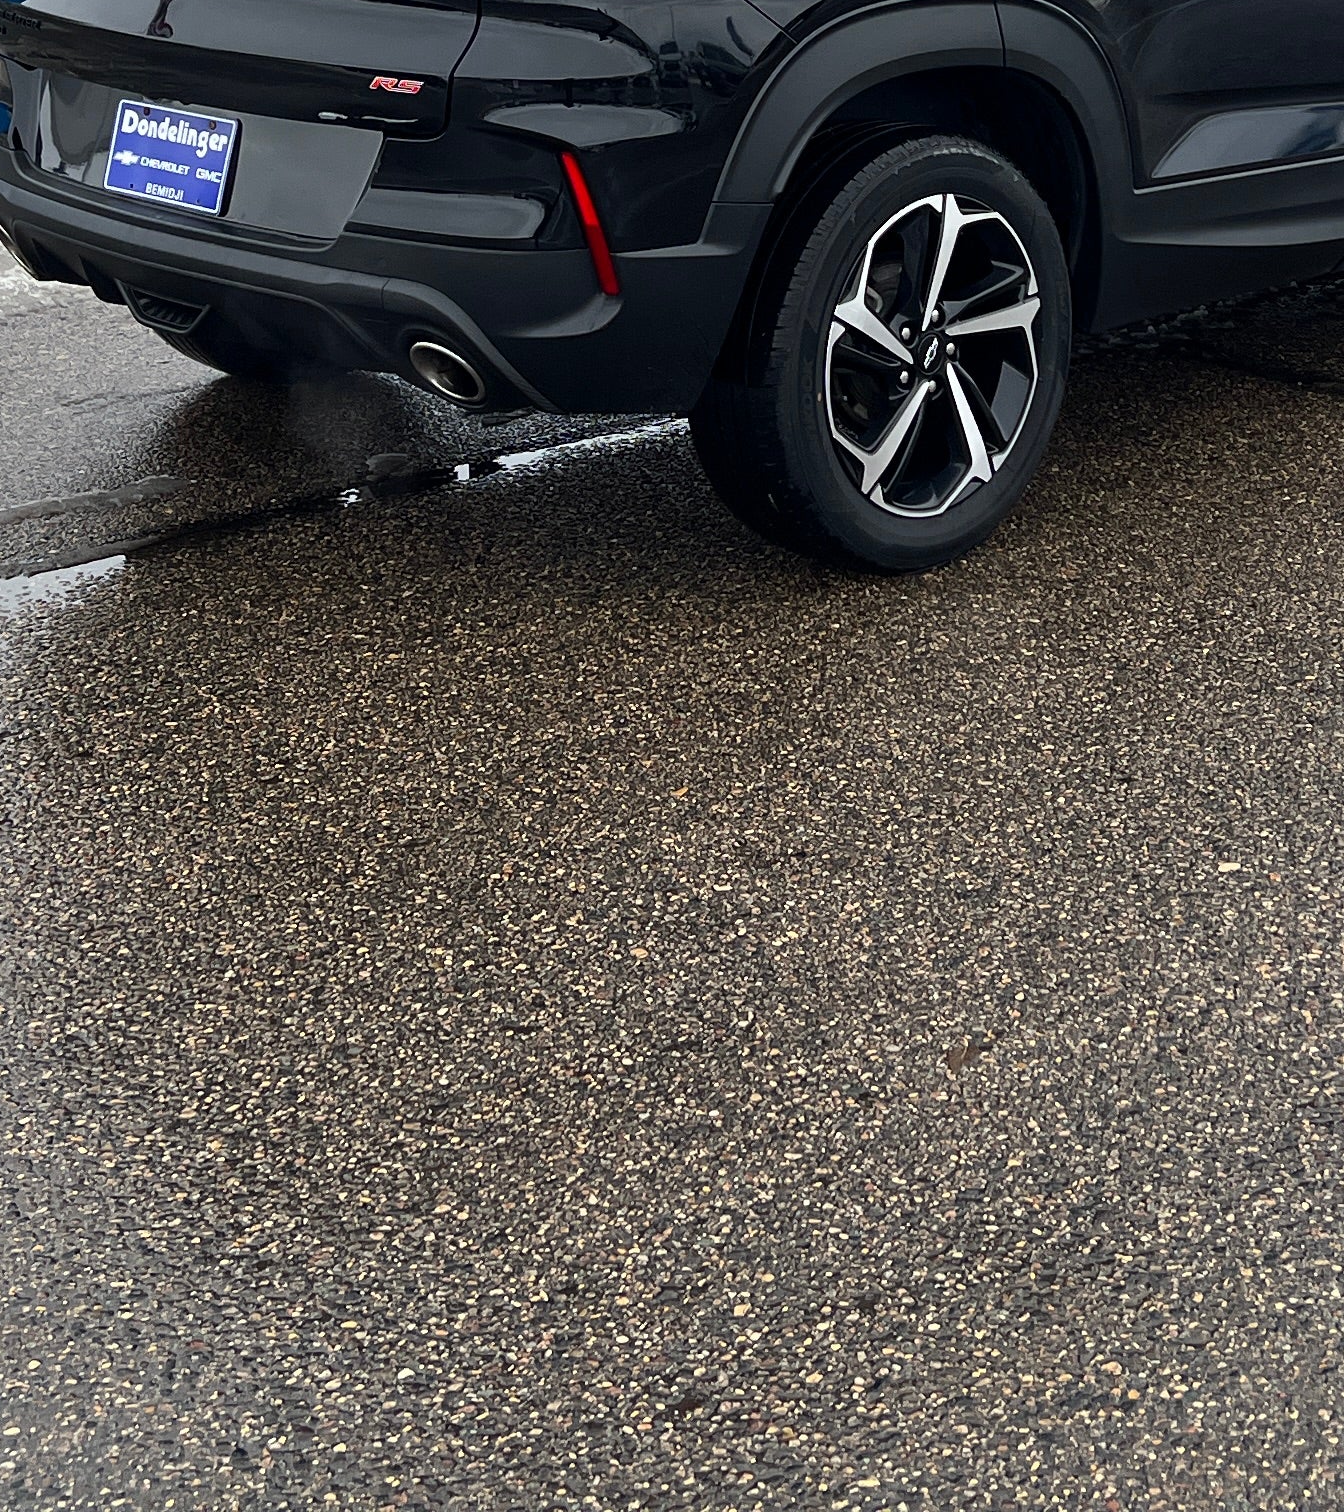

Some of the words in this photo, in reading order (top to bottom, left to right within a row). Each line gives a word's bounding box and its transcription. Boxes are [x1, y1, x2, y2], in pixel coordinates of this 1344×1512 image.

[369, 76, 424, 94] RS
[121, 108, 228, 158] Dondelinger
[140, 156, 190, 175] CHEVROLET
[195, 167, 223, 183] GMC
[145, 182, 184, 201] BEMIDJI
